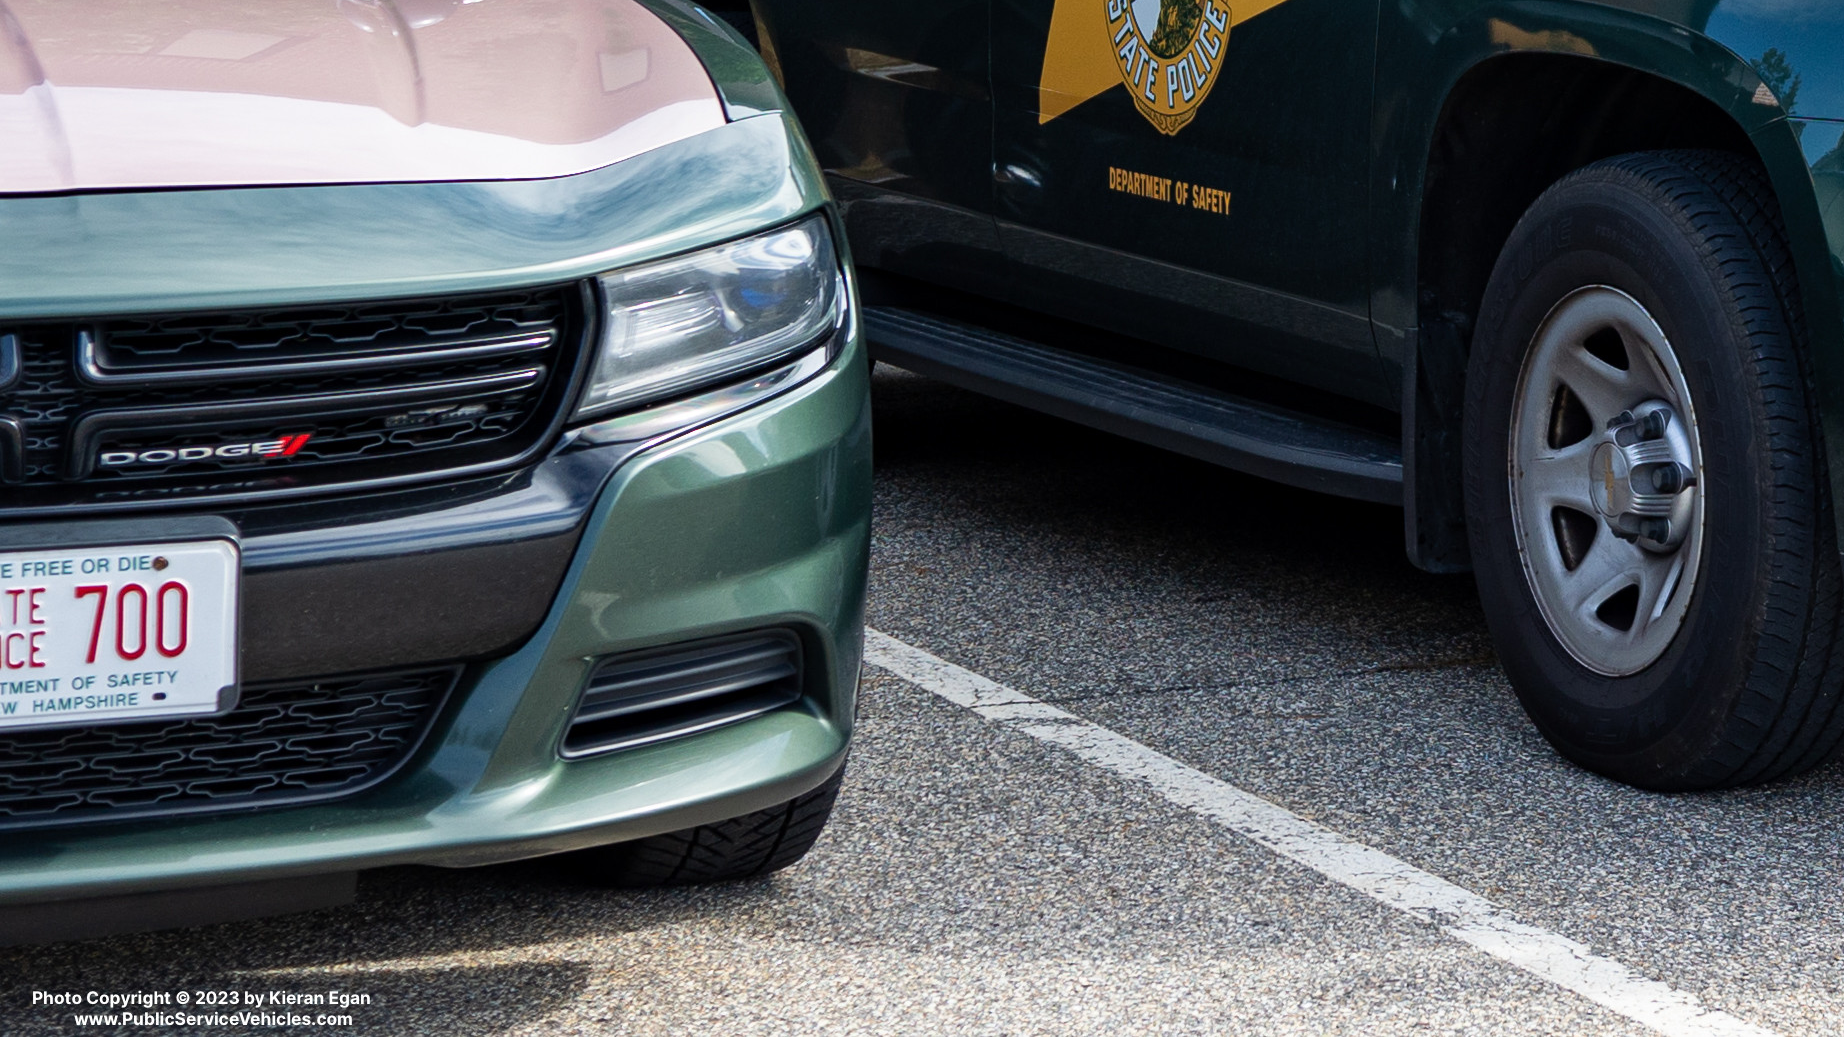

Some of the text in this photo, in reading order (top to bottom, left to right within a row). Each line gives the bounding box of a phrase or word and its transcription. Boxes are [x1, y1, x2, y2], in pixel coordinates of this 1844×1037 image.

[1167, 0, 1227, 107] POLICE
[1109, 166, 1231, 215] DEPARTMENT OF SAFETY
[101, 440, 284, 465] DODGE
[21, 560, 73, 577] FREE
[81, 558, 109, 574] OR
[118, 555, 152, 572] DIE
[74, 580, 188, 664] 700
[71, 676, 96, 691] OF
[107, 670, 178, 687] SAFETY
[33, 692, 139, 713] HAMPSHIRE
